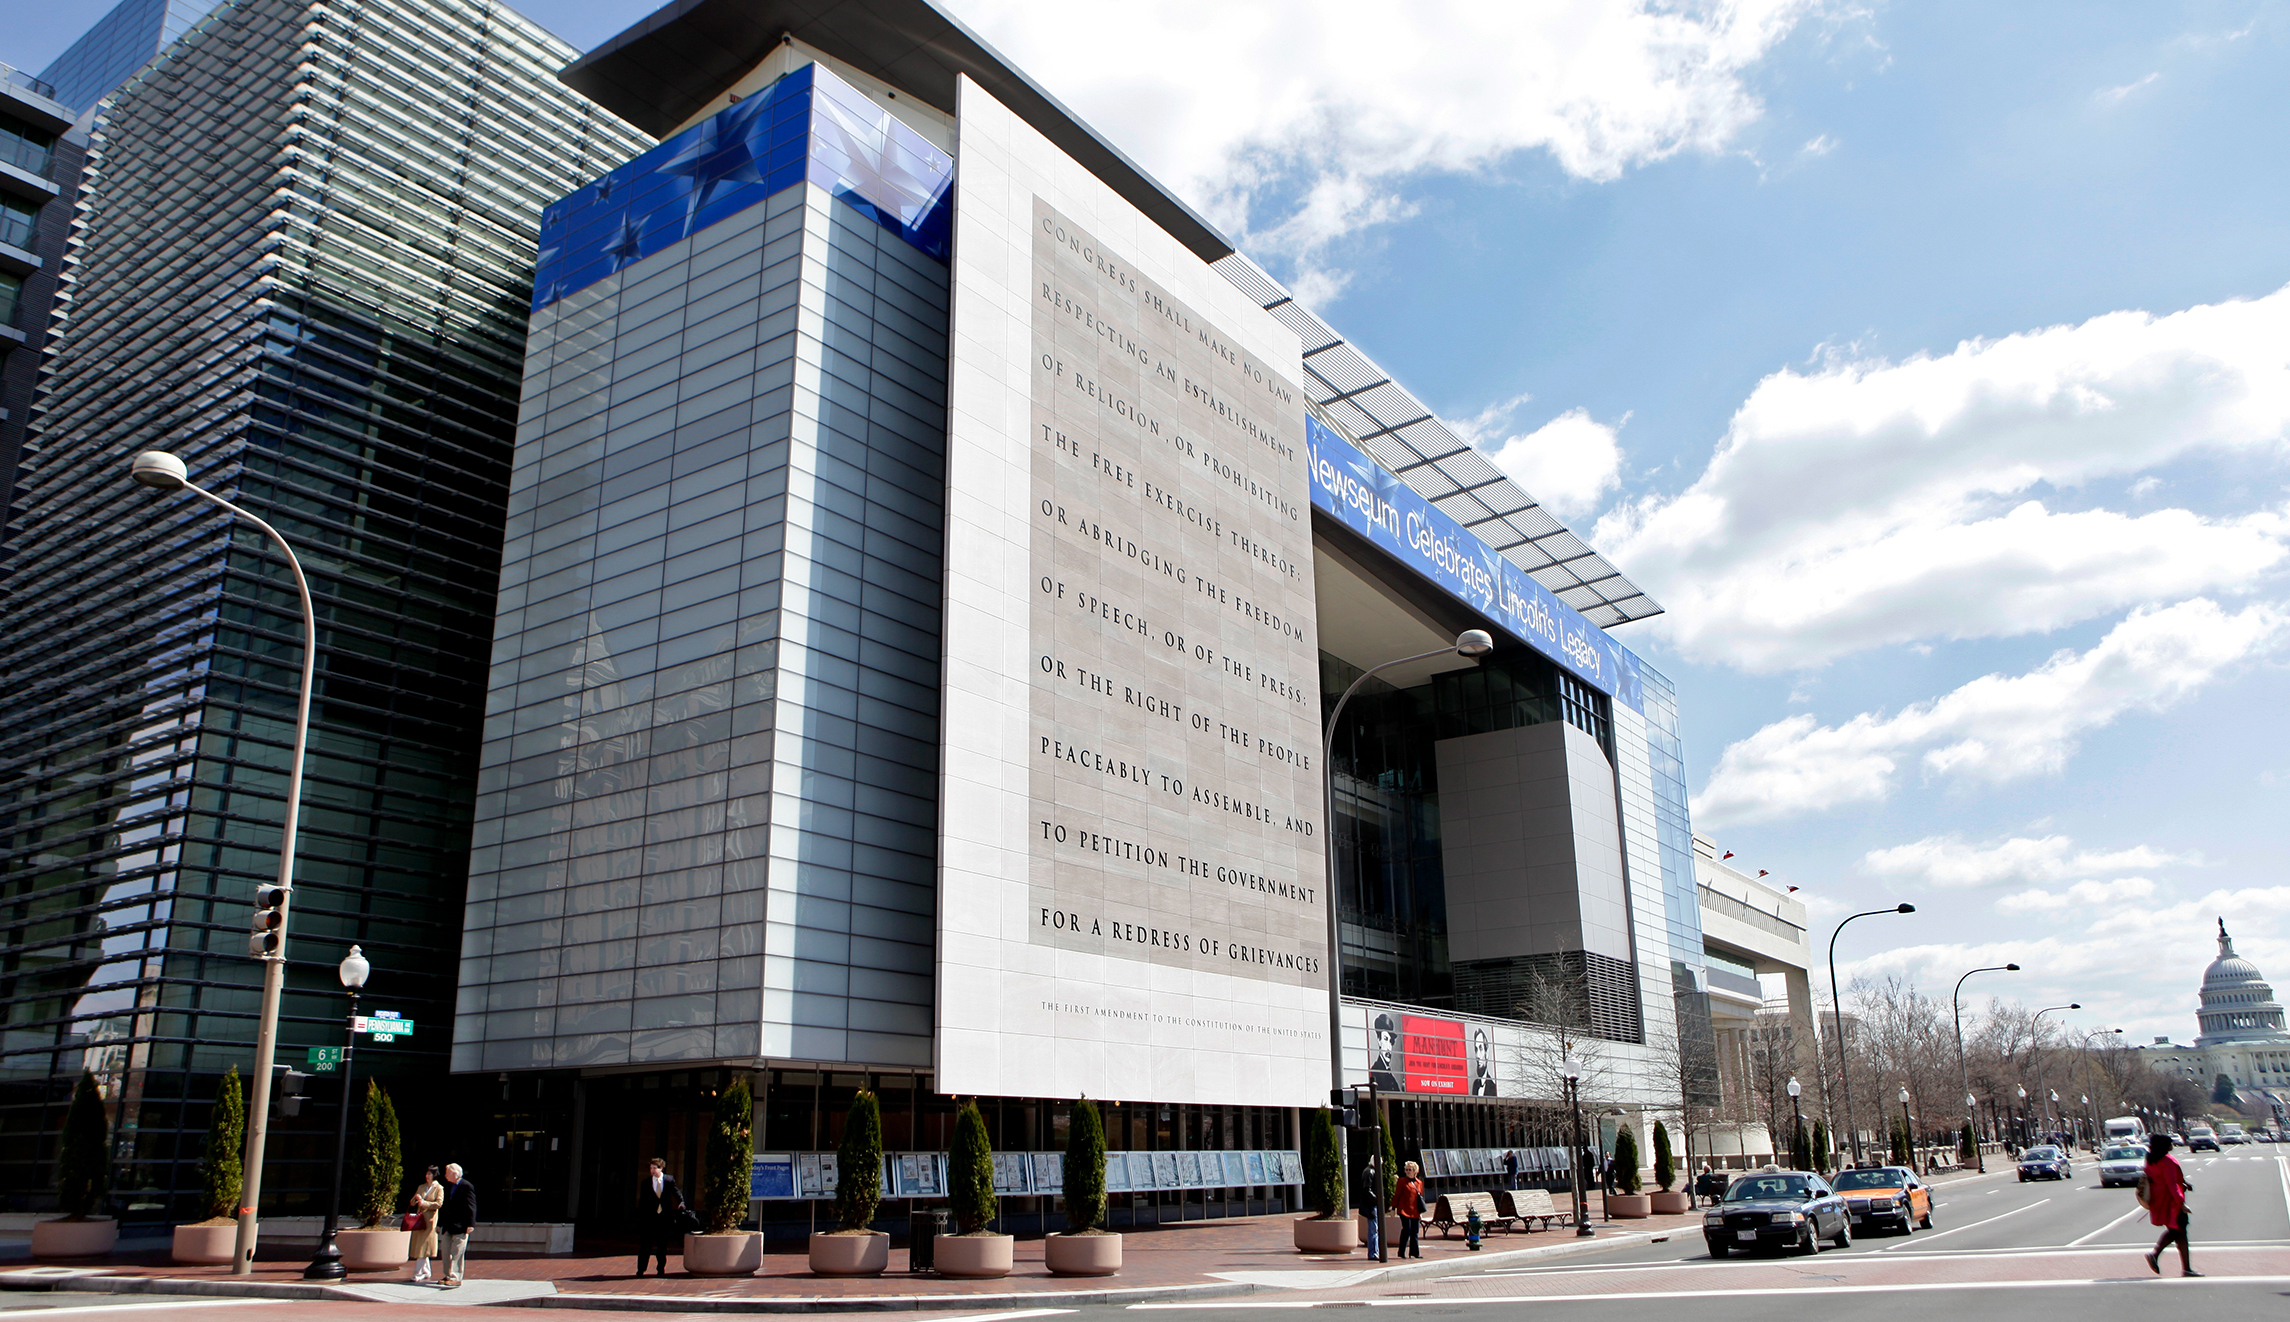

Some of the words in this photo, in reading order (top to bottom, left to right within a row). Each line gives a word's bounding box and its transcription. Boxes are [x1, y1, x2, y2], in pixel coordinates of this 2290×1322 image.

[1042, 217, 1136, 293] CONGRESS
[1144, 290, 1191, 334] SHALL
[1199, 329, 1236, 366] MAKE
[1243, 362, 1263, 384] NO
[1268, 379, 1292, 406] LAW
[1042, 282, 1149, 365] RESPECTING
[1156, 361, 1176, 383] AN
[1184, 378, 1295, 462] ESTABLISHMENT
[1041, 424, 1080, 458] THE
[1093, 452, 1134, 488] FREE
[1145, 482, 1222, 537] EXERCISE
[1042, 353, 1063, 376] OF
[1175, 435, 1195, 458] OR
[1203, 452, 1298, 521] PROHIBITING
[1041, 499, 1068, 525] OR
[1078, 518, 1186, 584] ABRIDGING
[1195, 576, 1226, 604] THE
[1235, 597, 1304, 643] FREEDOM
[1305, 442, 1401, 539] Newseum
[1406, 511, 1494, 604] Celebrates
[1497, 572, 1557, 645] Lincoln's
[1559, 618, 1601, 681] Legacy
[1041, 576, 1065, 600] OF
[1164, 631, 1186, 654] OR
[1195, 644, 1213, 665] OF
[1222, 656, 1252, 682] THE
[1041, 655, 1067, 680] OR
[1077, 668, 1114, 697] THE
[1125, 686, 1182, 722] RIGHT
[1192, 713, 1210, 733] OF
[1220, 723, 1250, 748] THE
[1258, 738, 1310, 771] PEOPLE
[1041, 736, 1151, 787] PEACEABLY
[1160, 774, 1183, 796] TO
[1285, 815, 1314, 837] AND
[1041, 820, 1067, 843] TO
[1079, 830, 1169, 868] PETITION
[1178, 855, 1209, 878] THE
[1217, 866, 1315, 904] GOVERNMENT
[1041, 908, 1081, 933] FOR
[1091, 918, 1102, 936] A
[1112, 921, 1190, 952] REDRESS
[1199, 937, 1219, 956] OF
[1228, 943, 1319, 974] GRIEVANCES
[315, 1062, 333, 1071] 200
[318, 1049, 327, 1061] 6
[374, 1032, 394, 1042] 500
[1041, 1001, 1060, 1012] THE
[1064, 1003, 1090, 1015] FIRST
[1094, 1007, 1149, 1022] AMENDMENT
[1152, 1013, 1164, 1024] TO
[1166, 1015, 1182, 1026] THE
[1185, 1017, 1243, 1032] CONSTITUTION
[1245, 1024, 1255, 1033] OF
[1257, 1025, 1271, 1035] THE
[1272, 1027, 1298, 1038] UNITED
[1300, 1030, 1322, 1040] STATES
